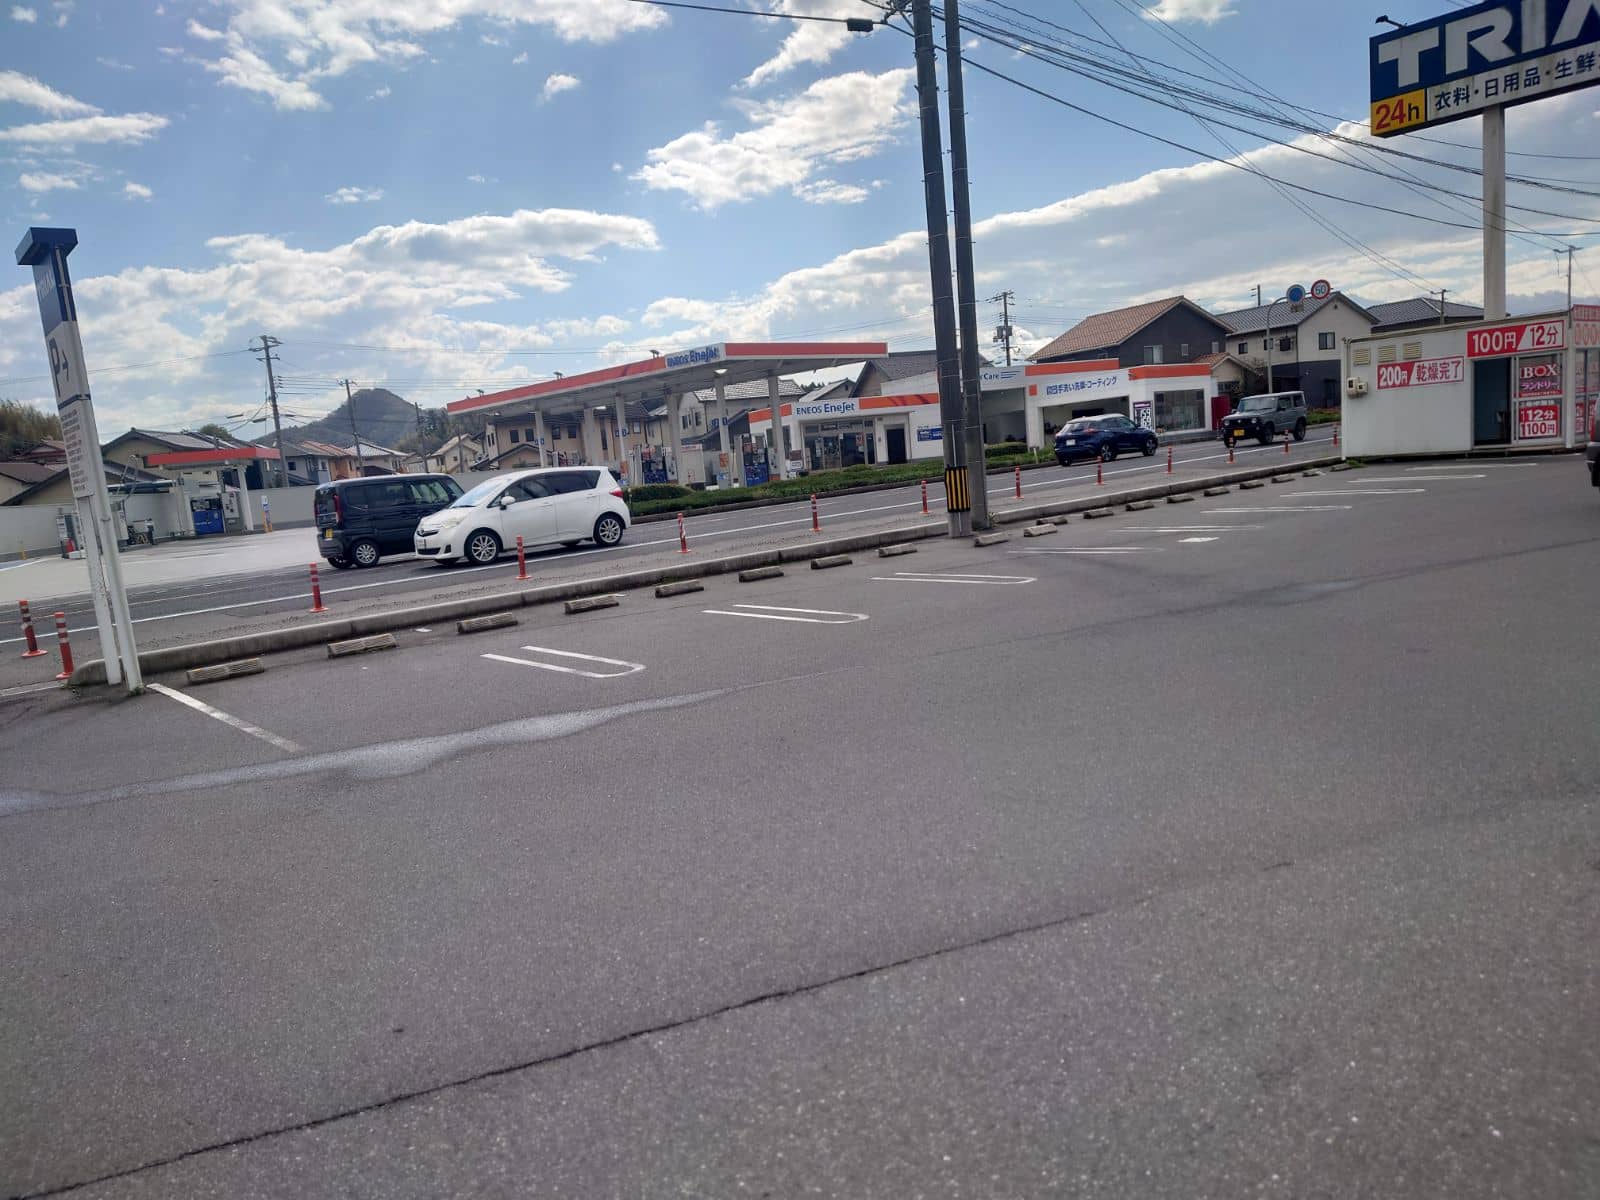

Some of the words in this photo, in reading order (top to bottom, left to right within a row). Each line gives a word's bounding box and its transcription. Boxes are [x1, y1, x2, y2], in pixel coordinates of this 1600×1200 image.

[1435, 51, 1600, 112] 衣料・日用品・生鮮
[1375, 99, 1420, 130] 24h
[1473, 331, 1516, 353] 100円
[1530, 325, 1558, 347] 12分
[1380, 366, 1408, 386] 200円
[1416, 360, 1461, 383] 乾燥完了
[796, 406, 822, 415] ENEOS
